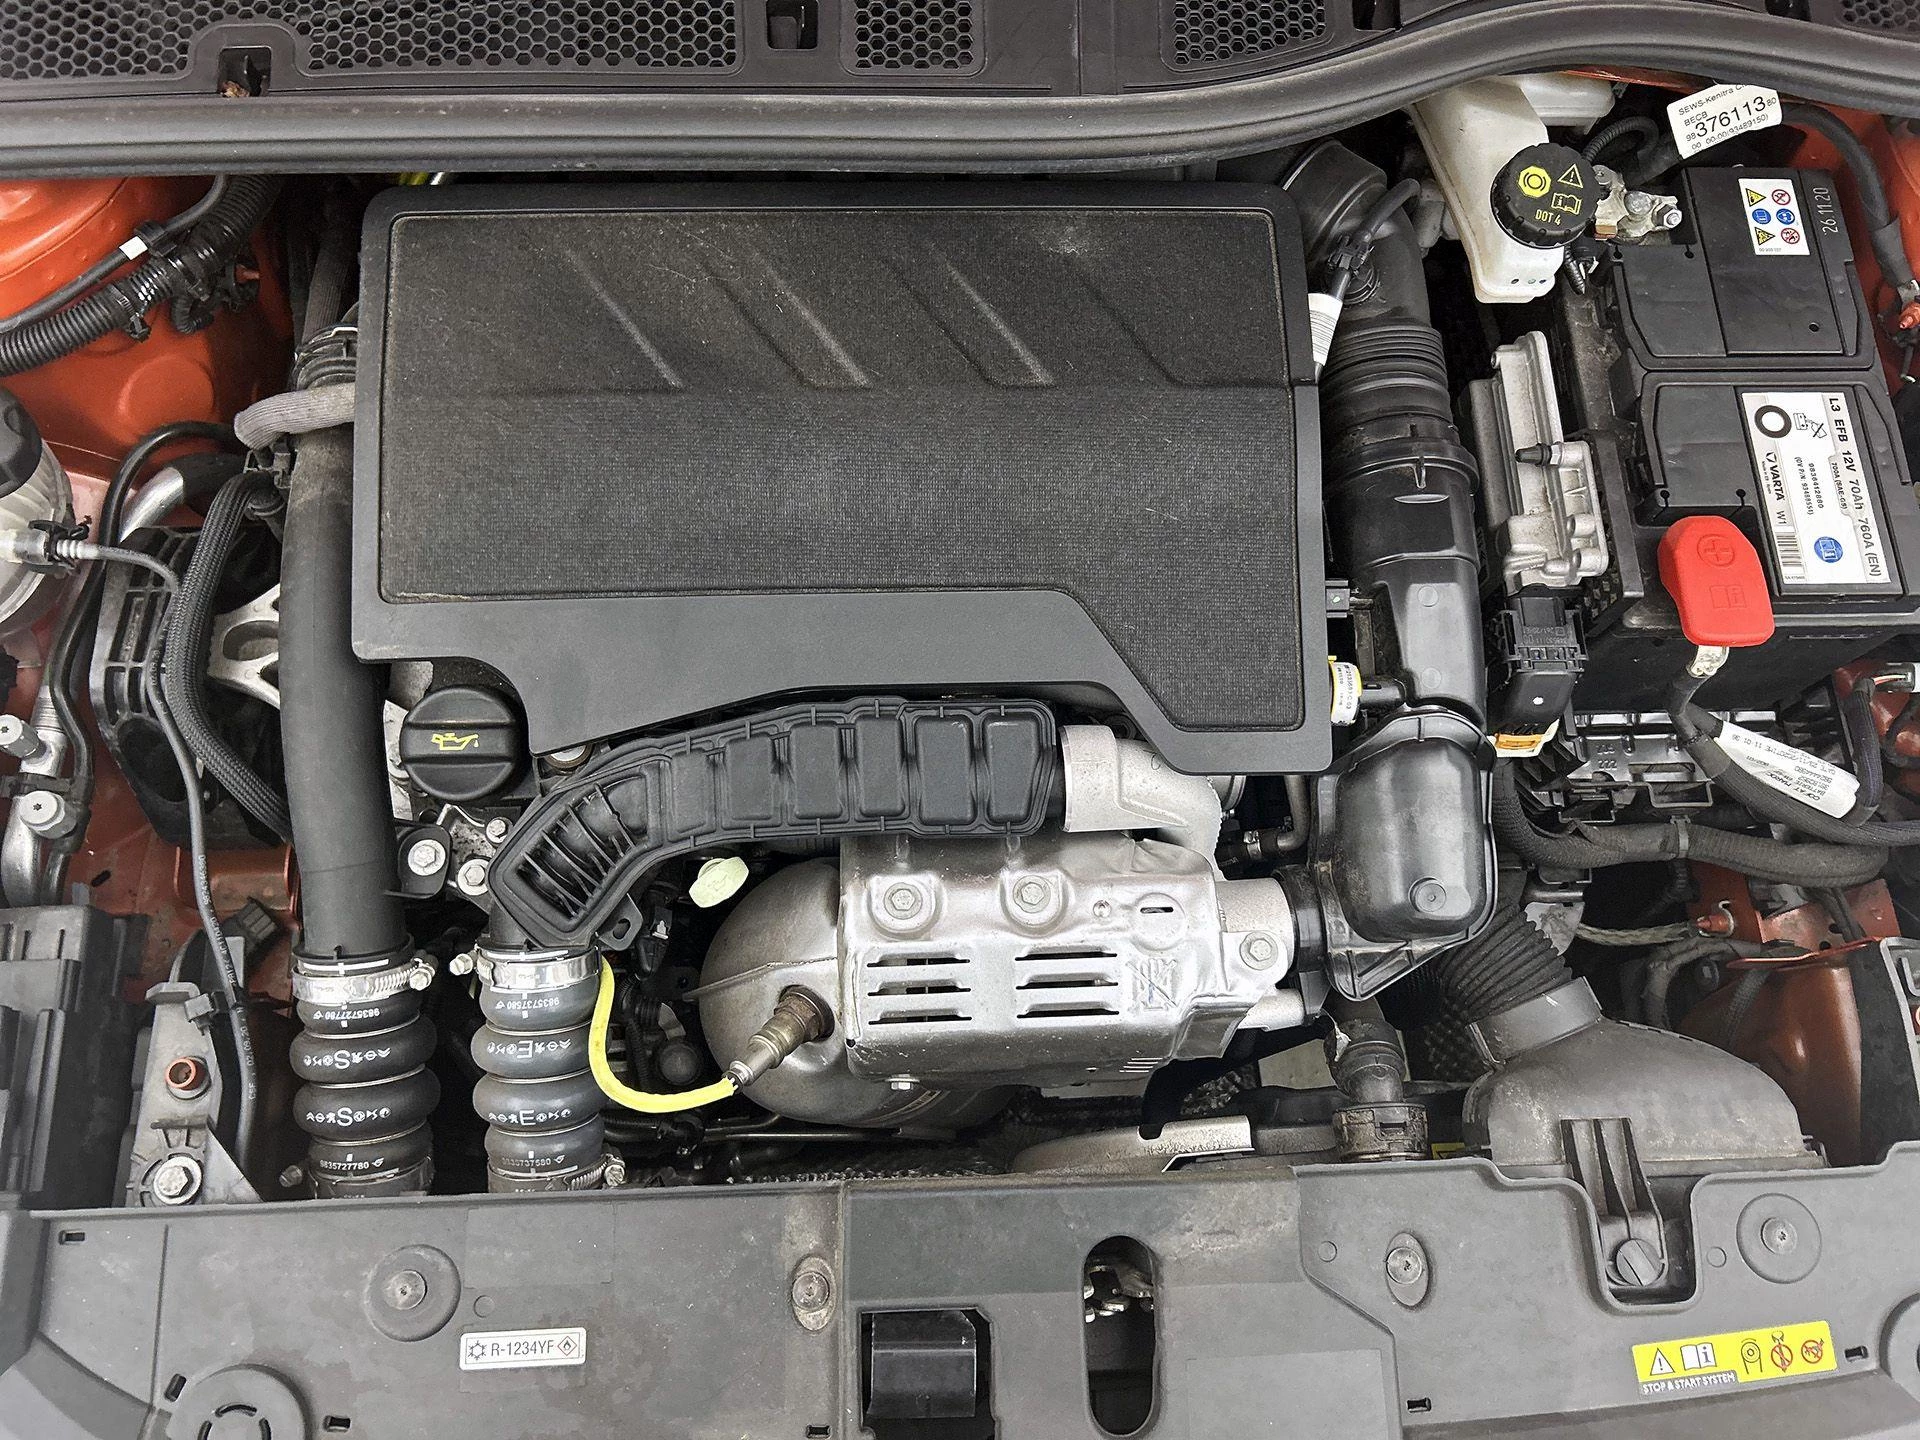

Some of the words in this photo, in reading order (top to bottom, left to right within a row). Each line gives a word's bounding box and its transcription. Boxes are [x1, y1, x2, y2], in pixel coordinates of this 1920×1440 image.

[1535, 210, 1554, 222] DOT
[1555, 215, 1560, 225] 4
[1829, 398, 1840, 412] L3
[1834, 419, 1848, 442] EFB
[1842, 450, 1856, 472] 12V
[1769, 466, 1785, 500] VARTA
[1777, 511, 1786, 524] W1
[1849, 479, 1863, 510] 70Ah
[1858, 518, 1874, 549] 760A
[1865, 552, 1881, 576] (EN)
[491, 1340, 554, 1356] R-1234YF
[1642, 1382, 1666, 1394] STOP
[1668, 1381, 1674, 1391] &
[1675, 1377, 1701, 1390] START
[1702, 1372, 1735, 1386] SYSTEM
